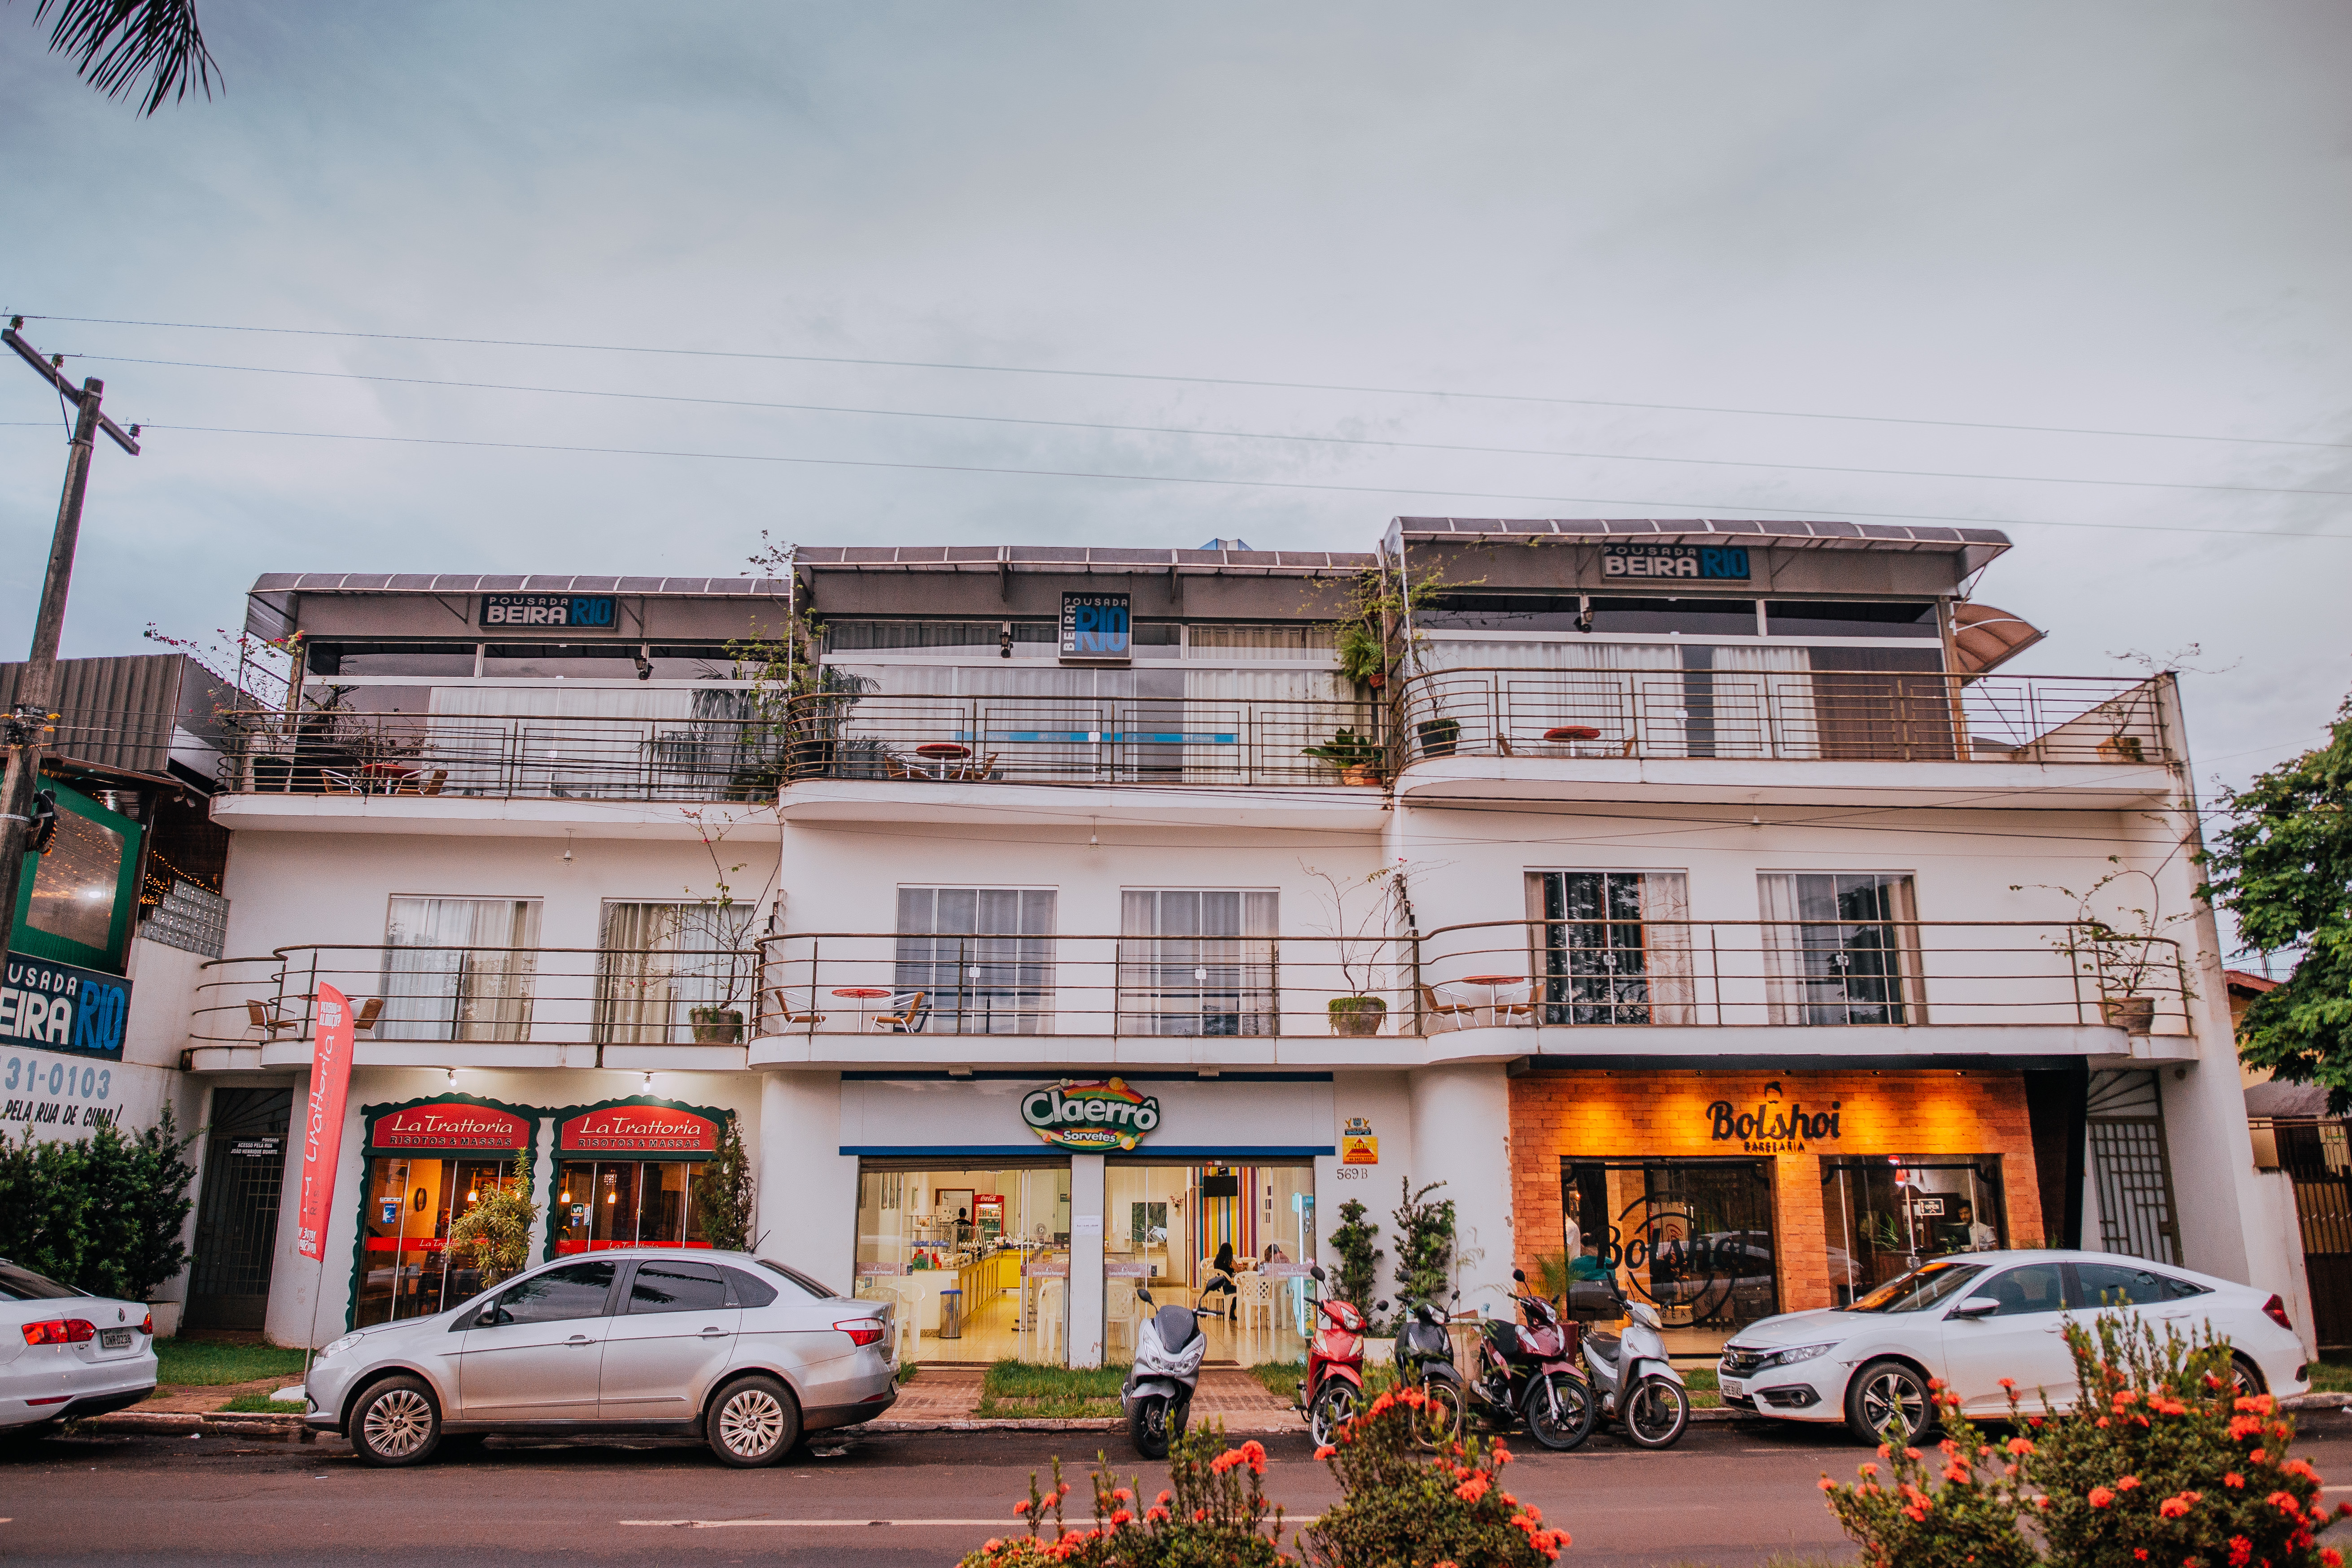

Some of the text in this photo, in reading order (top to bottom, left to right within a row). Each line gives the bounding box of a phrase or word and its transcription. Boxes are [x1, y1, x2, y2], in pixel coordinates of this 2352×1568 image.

[1604, 546, 1697, 556] POUSADA
[1605, 548, 1749, 577] BEIRA RIO
[487, 598, 611, 625] BEIRA RIO
[489, 597, 568, 605] POUSADA
[1064, 598, 1128, 607] POUSADA
[1063, 604, 1128, 652] BEIRA RIO
[75, 980, 125, 1050] RIO
[0, 1055, 111, 1100] 31-0103
[324, 1045, 341, 1111] MASSAS
[5, 1099, 123, 1127] PELA RUA DE CIMA!
[1023, 1090, 1158, 1131] Claerrô
[1706, 1100, 1841, 1141] Bolshoi
[392, 1114, 513, 1133] La Trattoria
[580, 1117, 701, 1135] La Trattoria
[390, 1136, 446, 1145] RISOTOS
[460, 1137, 512, 1146] MASSAS
[578, 1139, 700, 1148] RISOTOS & MASSAS
[1063, 1130, 1116, 1143] Sorvetes
[1337, 1168, 1359, 1180] 569
